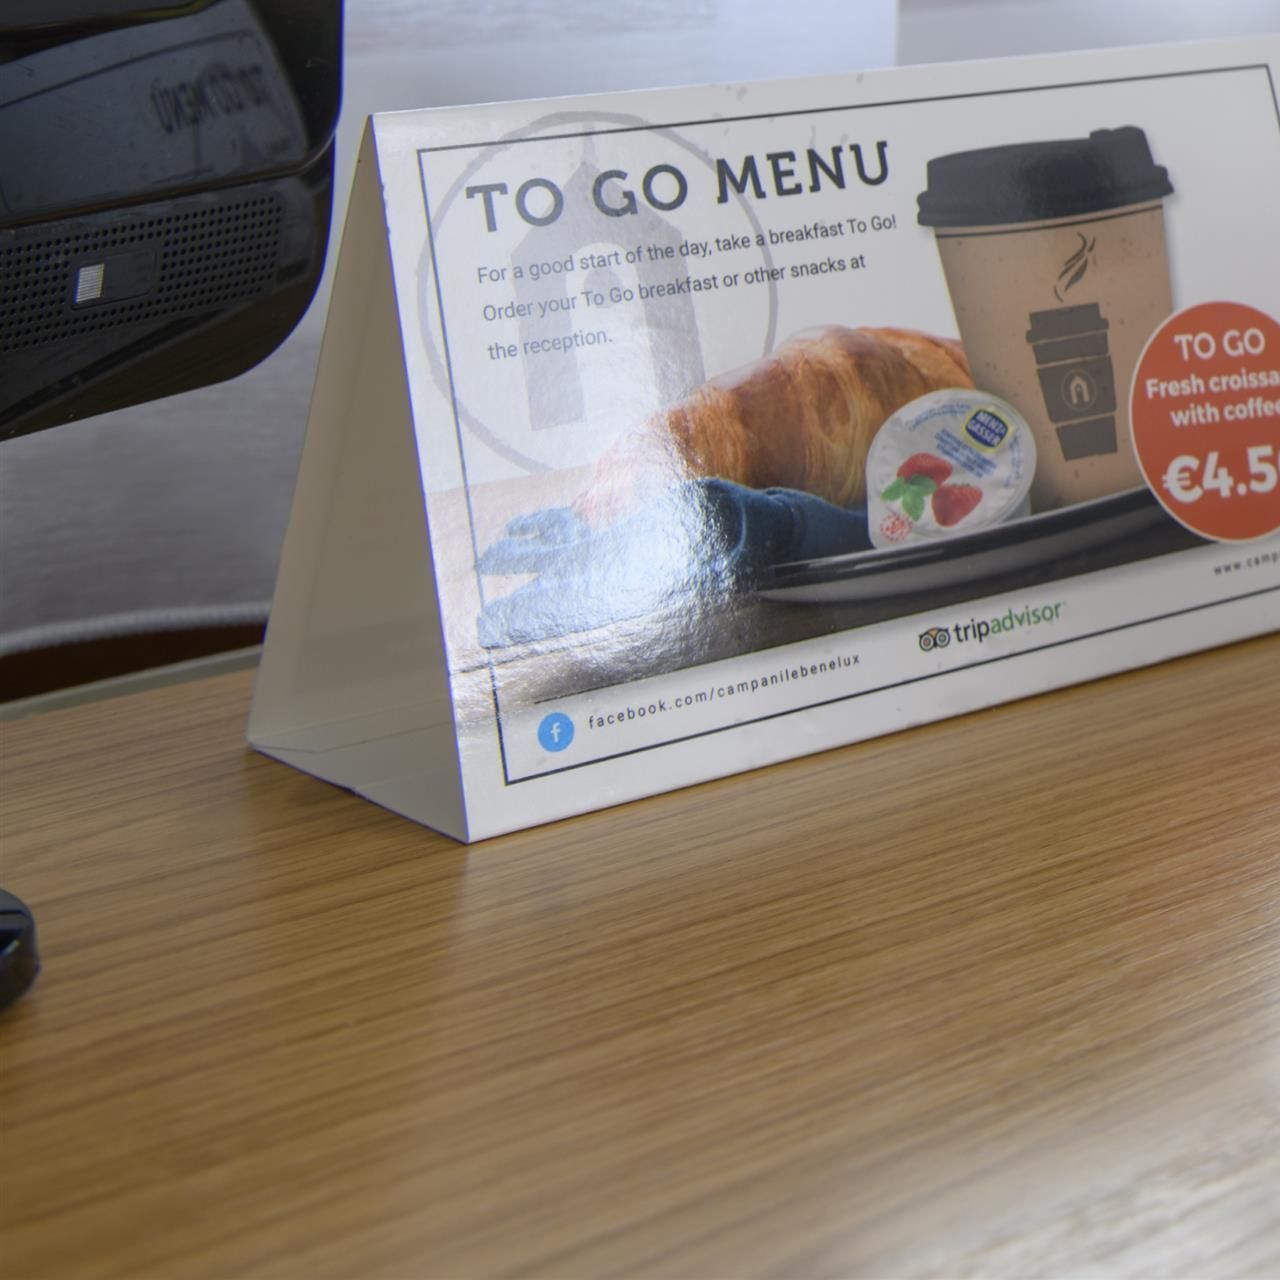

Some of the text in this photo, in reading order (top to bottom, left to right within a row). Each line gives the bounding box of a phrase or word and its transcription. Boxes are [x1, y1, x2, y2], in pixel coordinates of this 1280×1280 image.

[465, 140, 888, 232] TO GO MENU
[477, 214, 897, 284] For a good start of the day, take a breakfast To Go!
[483, 254, 866, 321] Order your To Go breakfast or other snacks at
[488, 329, 614, 361] the reception.
[1174, 328, 1266, 361] TO GO
[1146, 373, 1205, 399] Fresh
[1170, 402, 1220, 427] with
[952, 602, 1061, 642] tripadvisor
[588, 654, 861, 729] facebook.com/campanilebenelux
